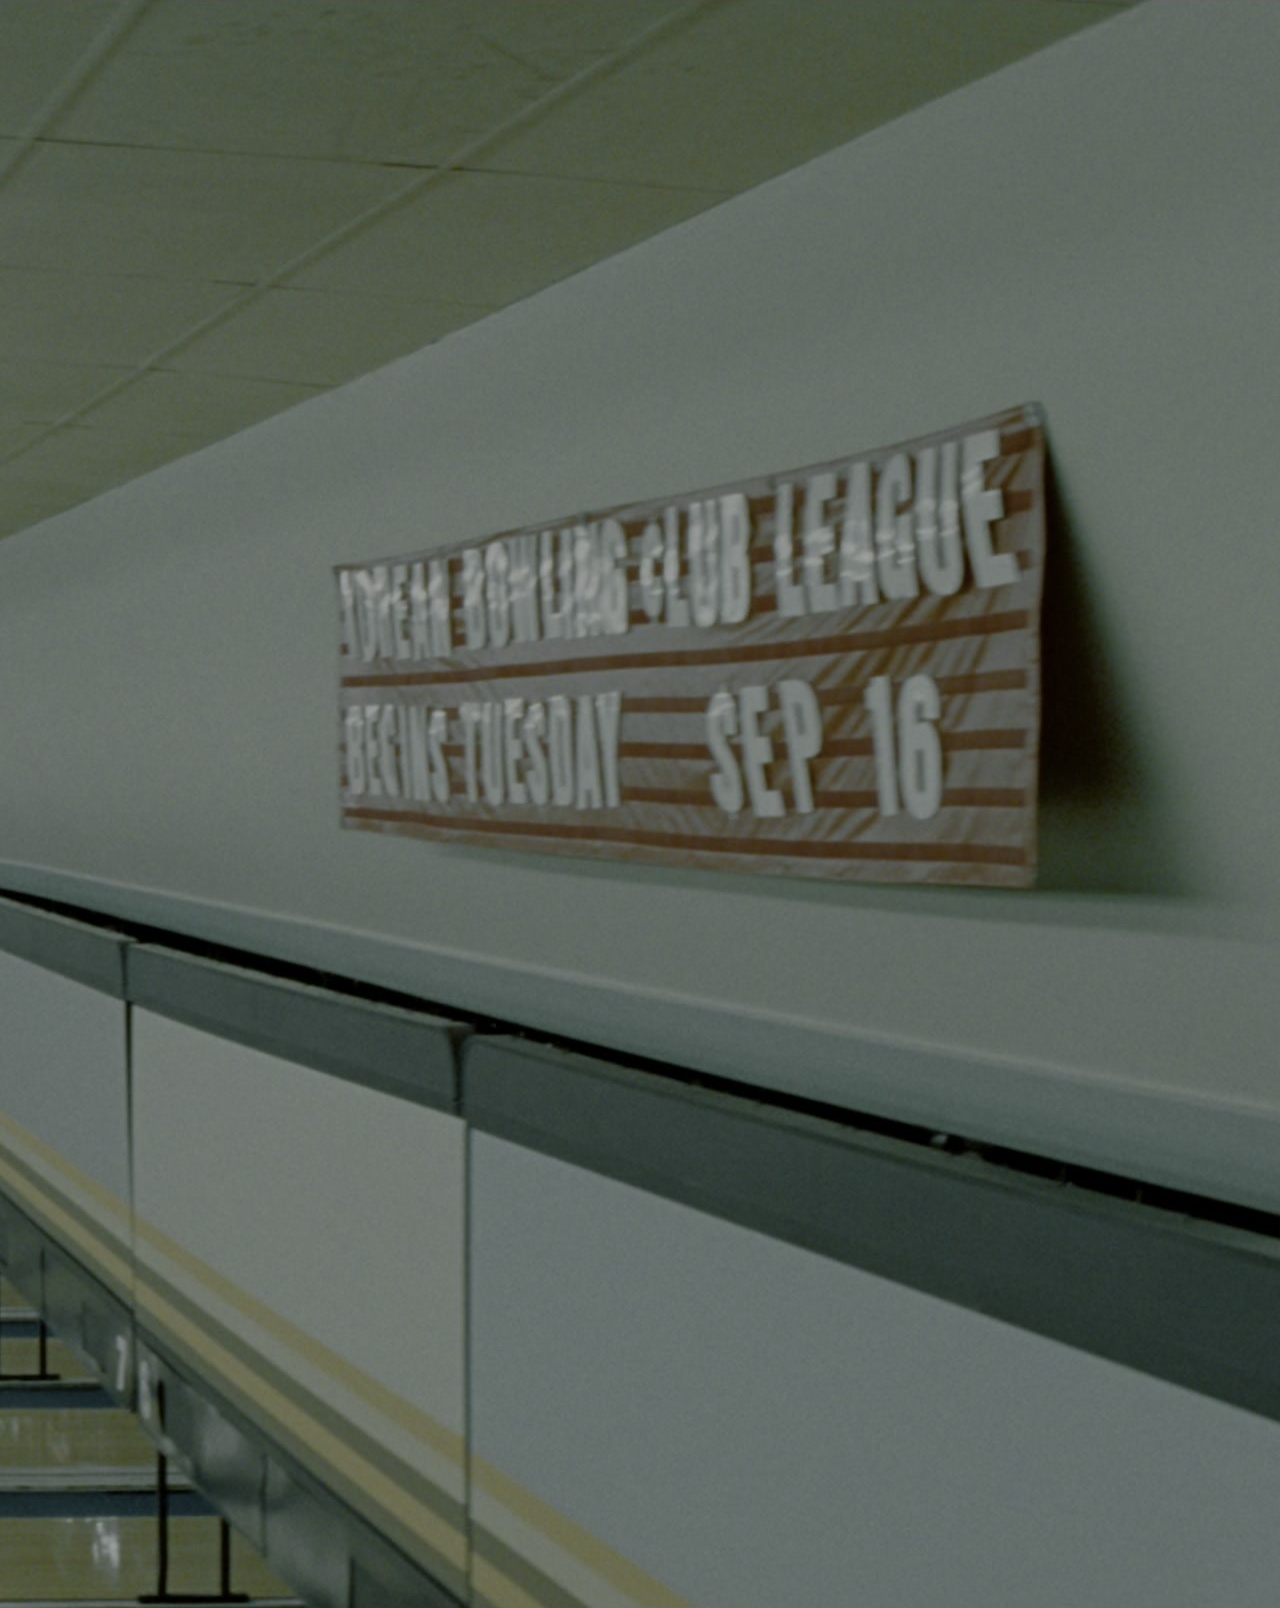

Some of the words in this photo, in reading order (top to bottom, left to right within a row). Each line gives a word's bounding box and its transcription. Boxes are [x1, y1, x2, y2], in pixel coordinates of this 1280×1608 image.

[462, 516, 631, 650] BOWLING
[773, 429, 1023, 618] LEAGUE
[345, 703, 450, 803] BEGINS
[460, 690, 623, 811] TUESDAY
[704, 676, 824, 820] SEP
[864, 673, 943, 821] 16
